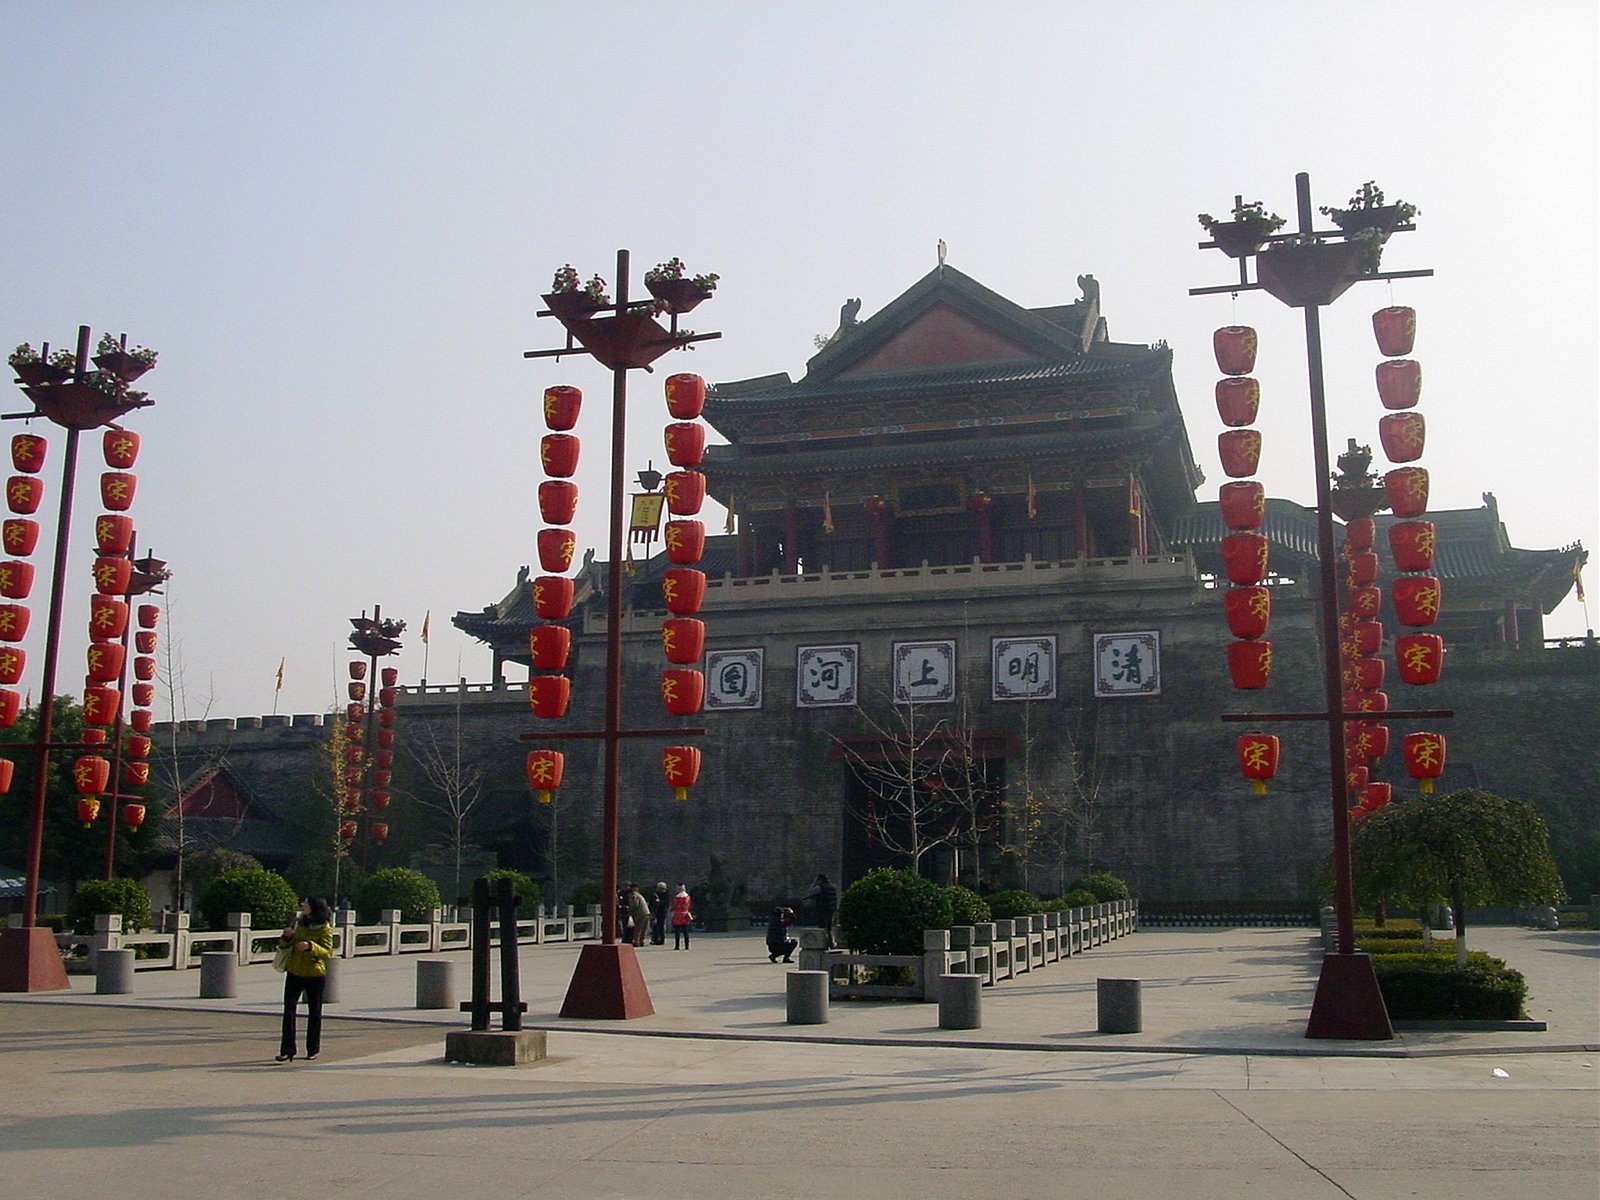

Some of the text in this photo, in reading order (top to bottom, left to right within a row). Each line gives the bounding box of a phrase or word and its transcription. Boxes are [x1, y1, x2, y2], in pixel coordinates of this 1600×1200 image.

[1415, 586, 1440, 616] 宋
[911, 658, 939, 687] 上
[1404, 643, 1432, 673] 宋
[1244, 741, 1269, 770] 宋
[1412, 739, 1441, 769] 宋
[532, 757, 554, 784] 宋
